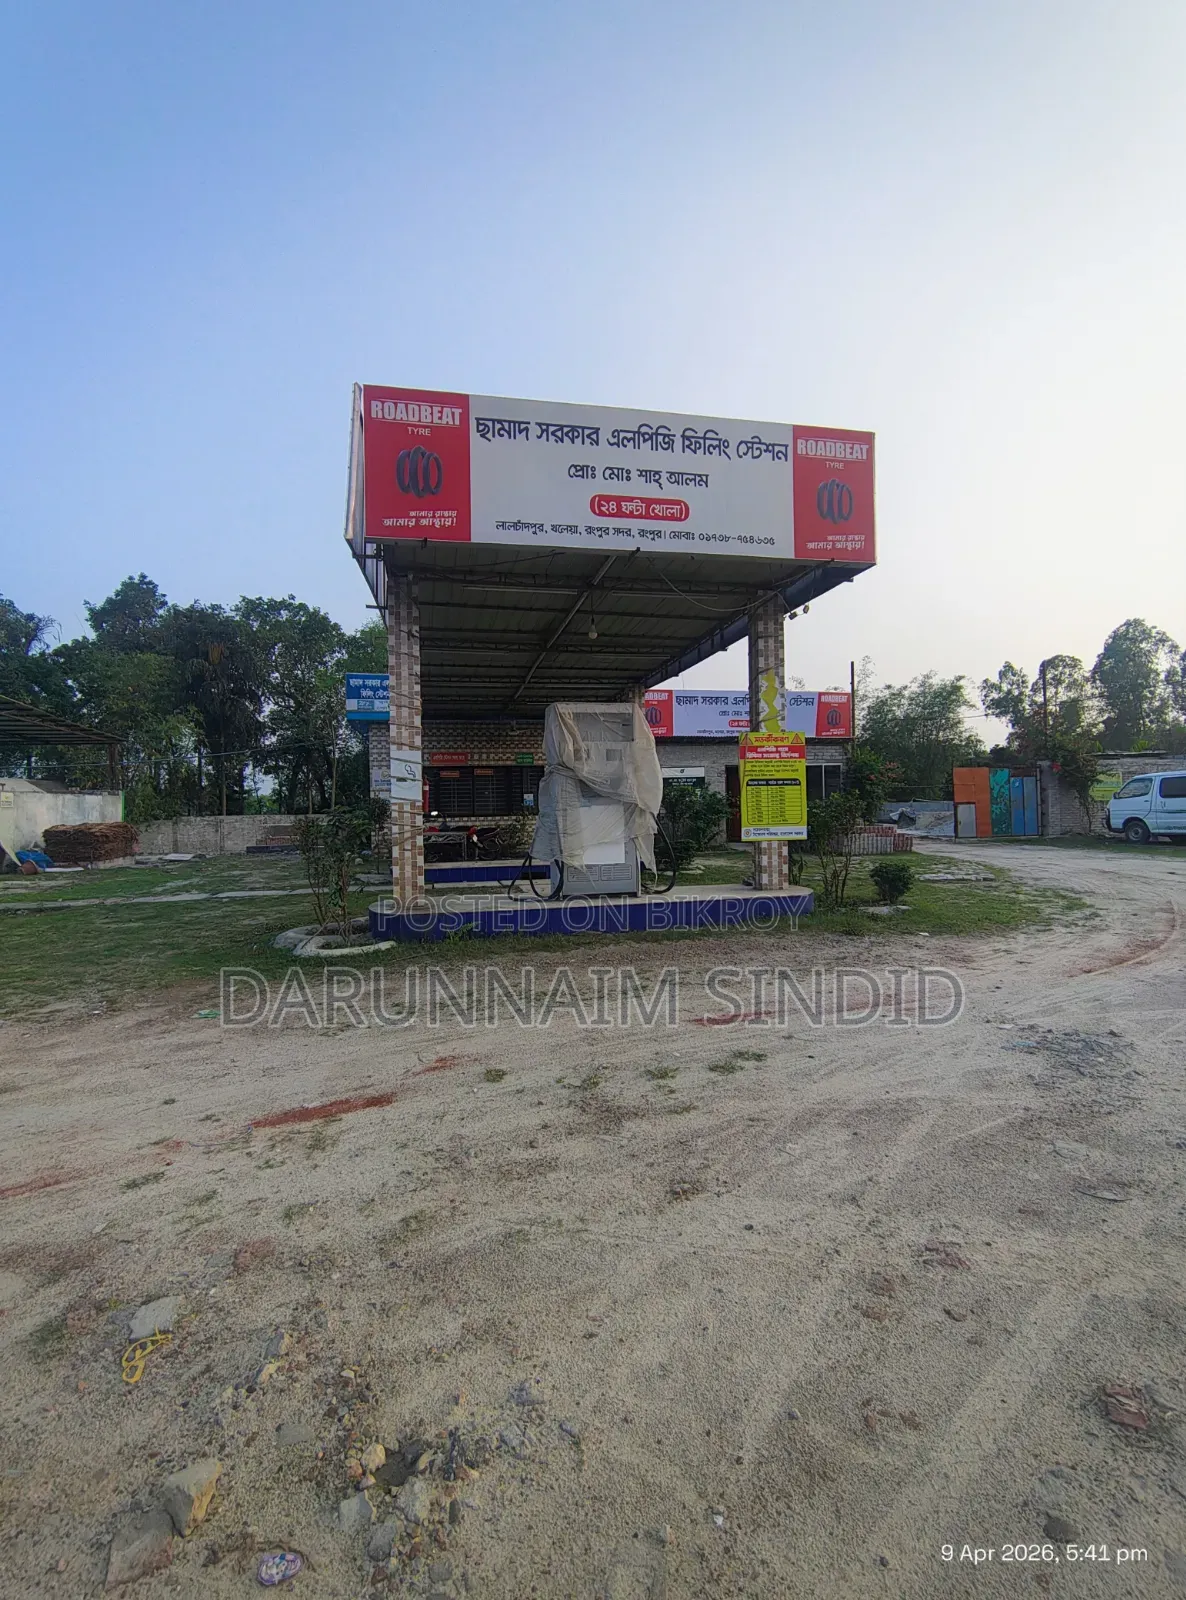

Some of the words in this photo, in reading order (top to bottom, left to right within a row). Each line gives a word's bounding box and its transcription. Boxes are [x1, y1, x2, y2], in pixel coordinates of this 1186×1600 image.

[371, 400, 463, 426] ROADBEAT
[407, 426, 432, 436] TYRE
[475, 417, 531, 442] ছামাদ
[535, 421, 600, 447] সরকার
[607, 423, 676, 453] এলপিজি
[681, 427, 732, 461] ফিলিং
[736, 435, 789, 462] স্টেশন
[796, 438, 869, 460] ROADBEAT
[825, 461, 845, 470] TYRE
[568, 463, 596, 480] প্রোঃ
[602, 466, 632, 482] মোঃ
[666, 471, 709, 488] আলম
[649, 502, 686, 519] খোলা)
[382, 518, 416, 528] আমার
[584, 525, 610, 539] রংপুর
[675, 695, 699, 707] ছামাদ
[701, 696, 729, 707] সরকার
[789, 694, 815, 707] স্টেশন
